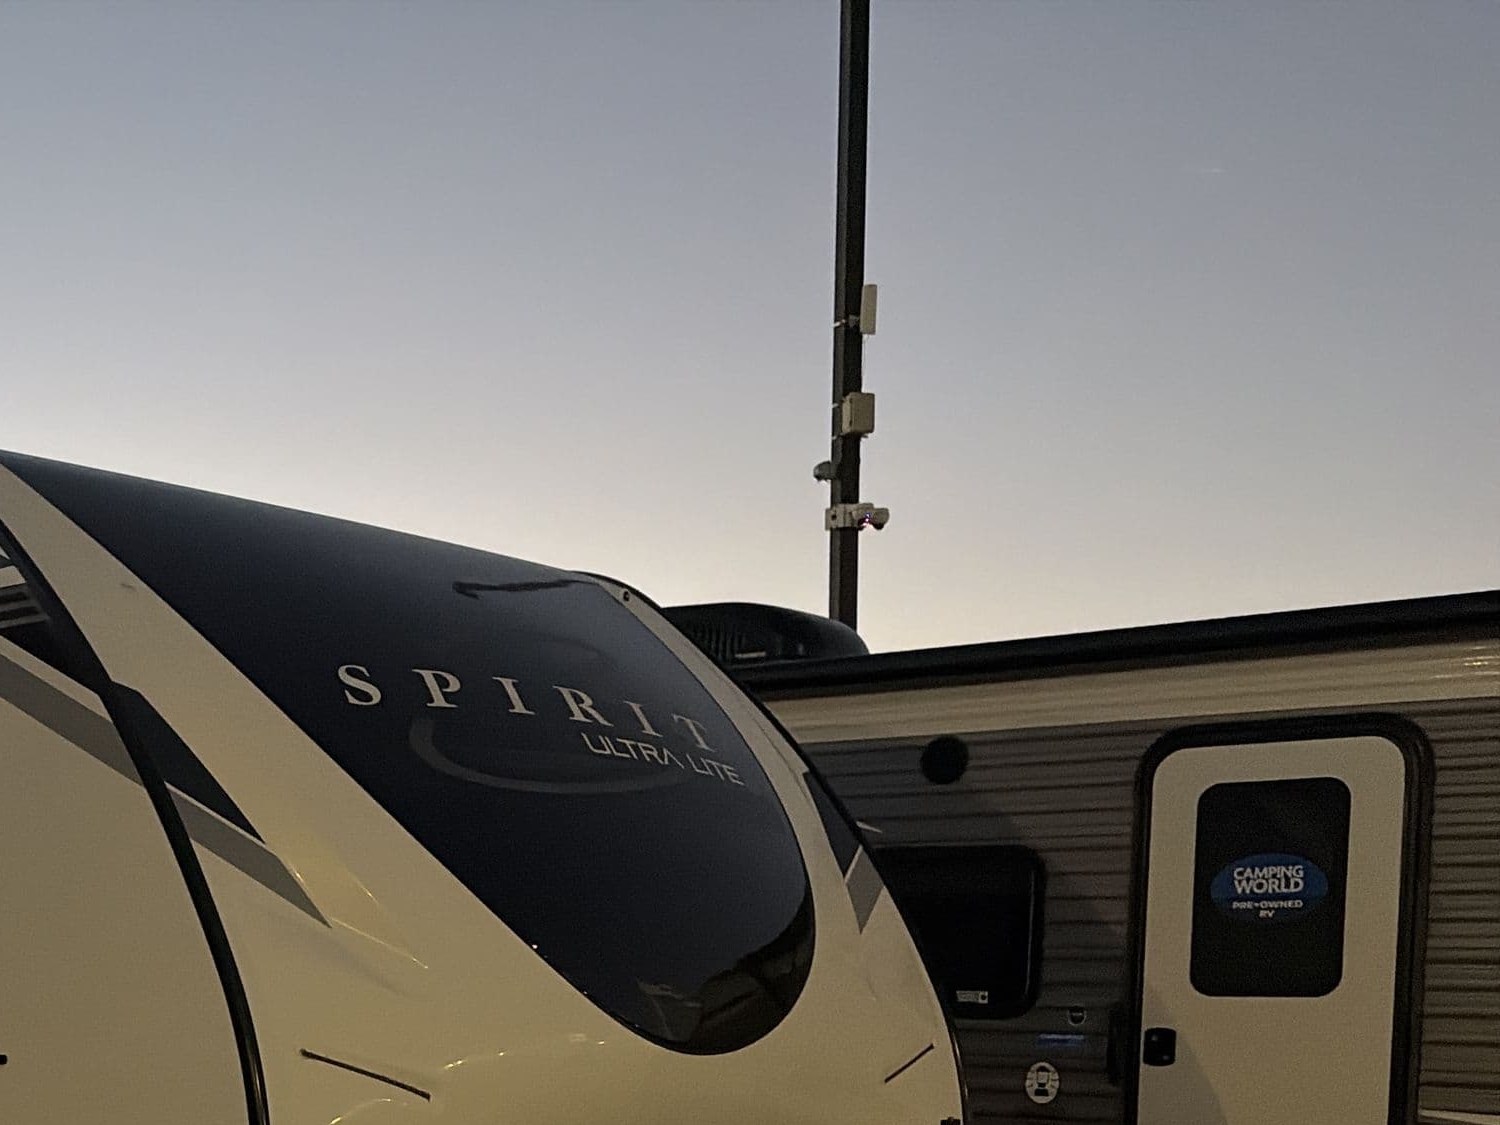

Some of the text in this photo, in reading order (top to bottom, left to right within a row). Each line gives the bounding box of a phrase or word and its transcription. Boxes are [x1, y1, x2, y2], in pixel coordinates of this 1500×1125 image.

[336, 663, 716, 754] SPIRIT
[580, 731, 748, 788] ULTRA LITE
[1233, 864, 1305, 880] CAMPING
[1233, 878, 1305, 895] WORLD
